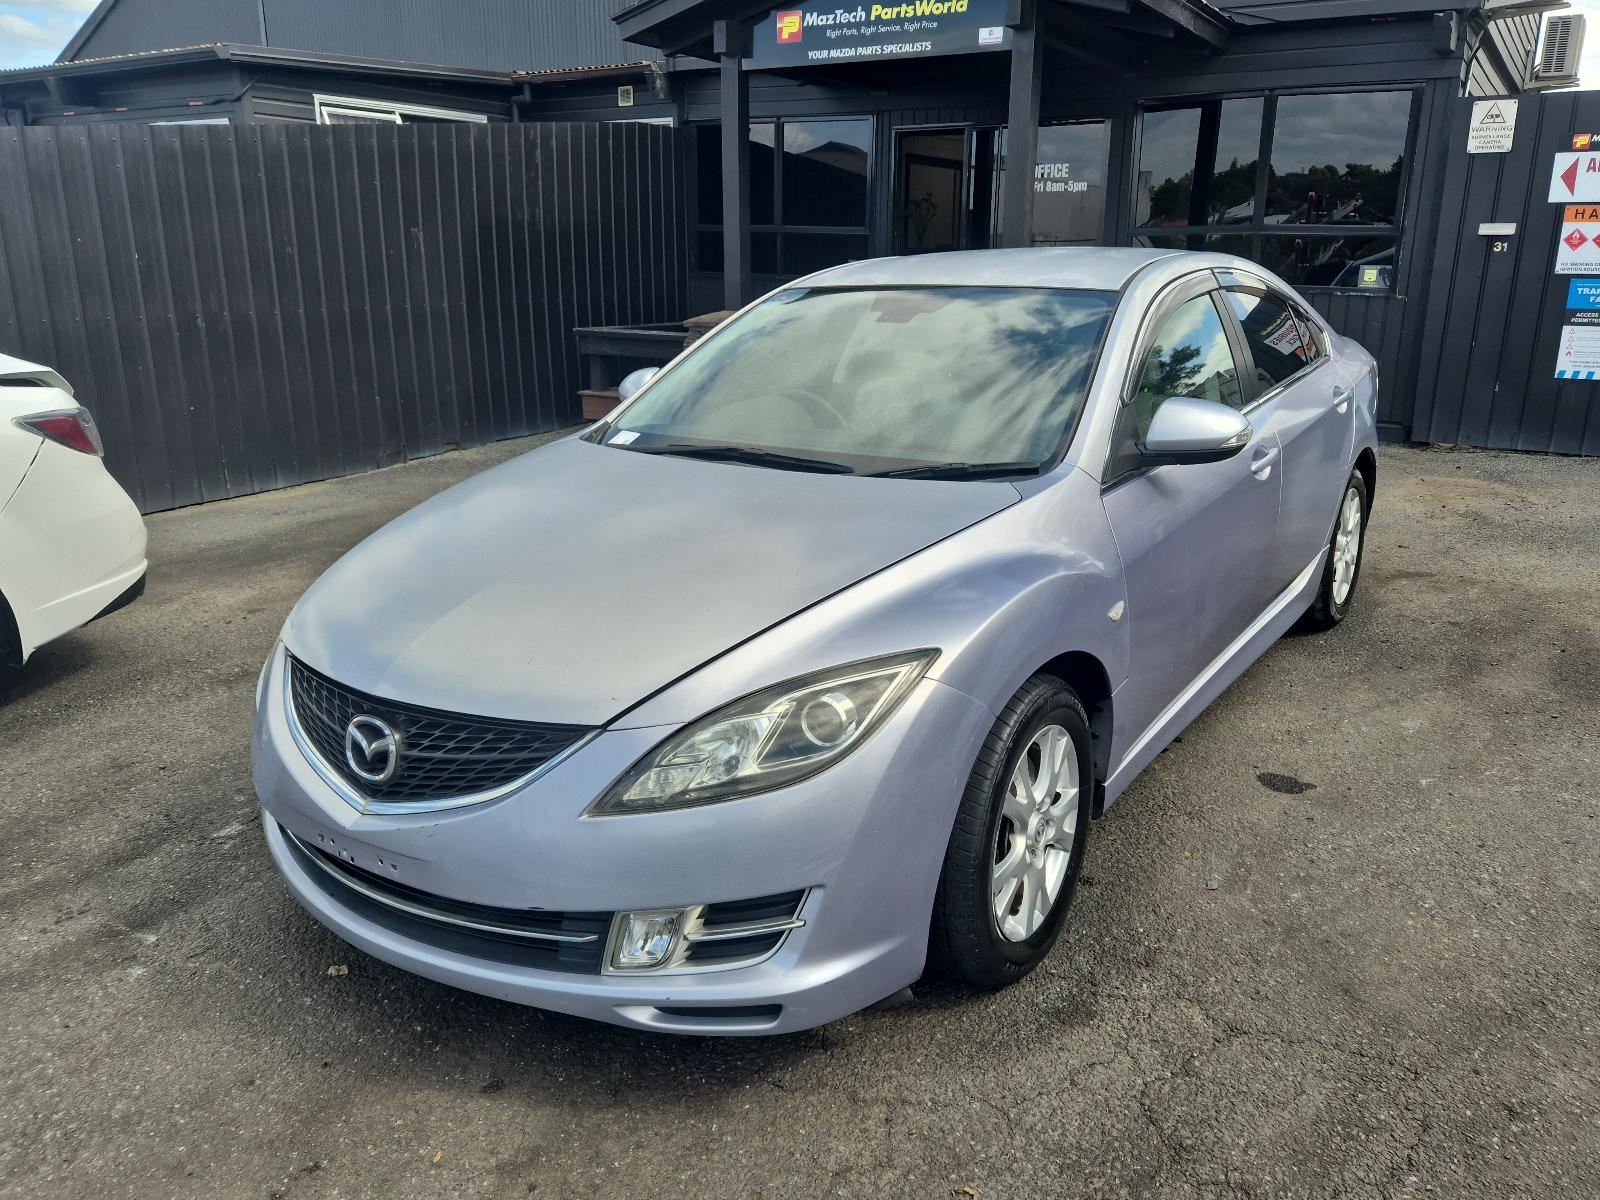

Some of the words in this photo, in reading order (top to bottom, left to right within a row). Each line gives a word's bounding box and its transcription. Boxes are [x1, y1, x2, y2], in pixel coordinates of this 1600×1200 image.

[803, 6, 866, 27] MazTech
[870, 0, 969, 21] PartsWorld
[826, 29, 842, 38] Right
[842, 27, 859, 36] Parts,
[860, 25, 877, 36] Right
[878, 23, 902, 33] Service,
[903, 21, 921, 31] Right
[921, 20, 938, 29] Price
[808, 50, 828, 60] YOUR
[829, 47, 856, 58] MAZDA
[856, 45, 882, 56] PARTS
[882, 41, 932, 54] SPECIALISTS
[1046, 180, 1088, 193] 8am-5pm
[1493, 241, 1508, 252] 31
